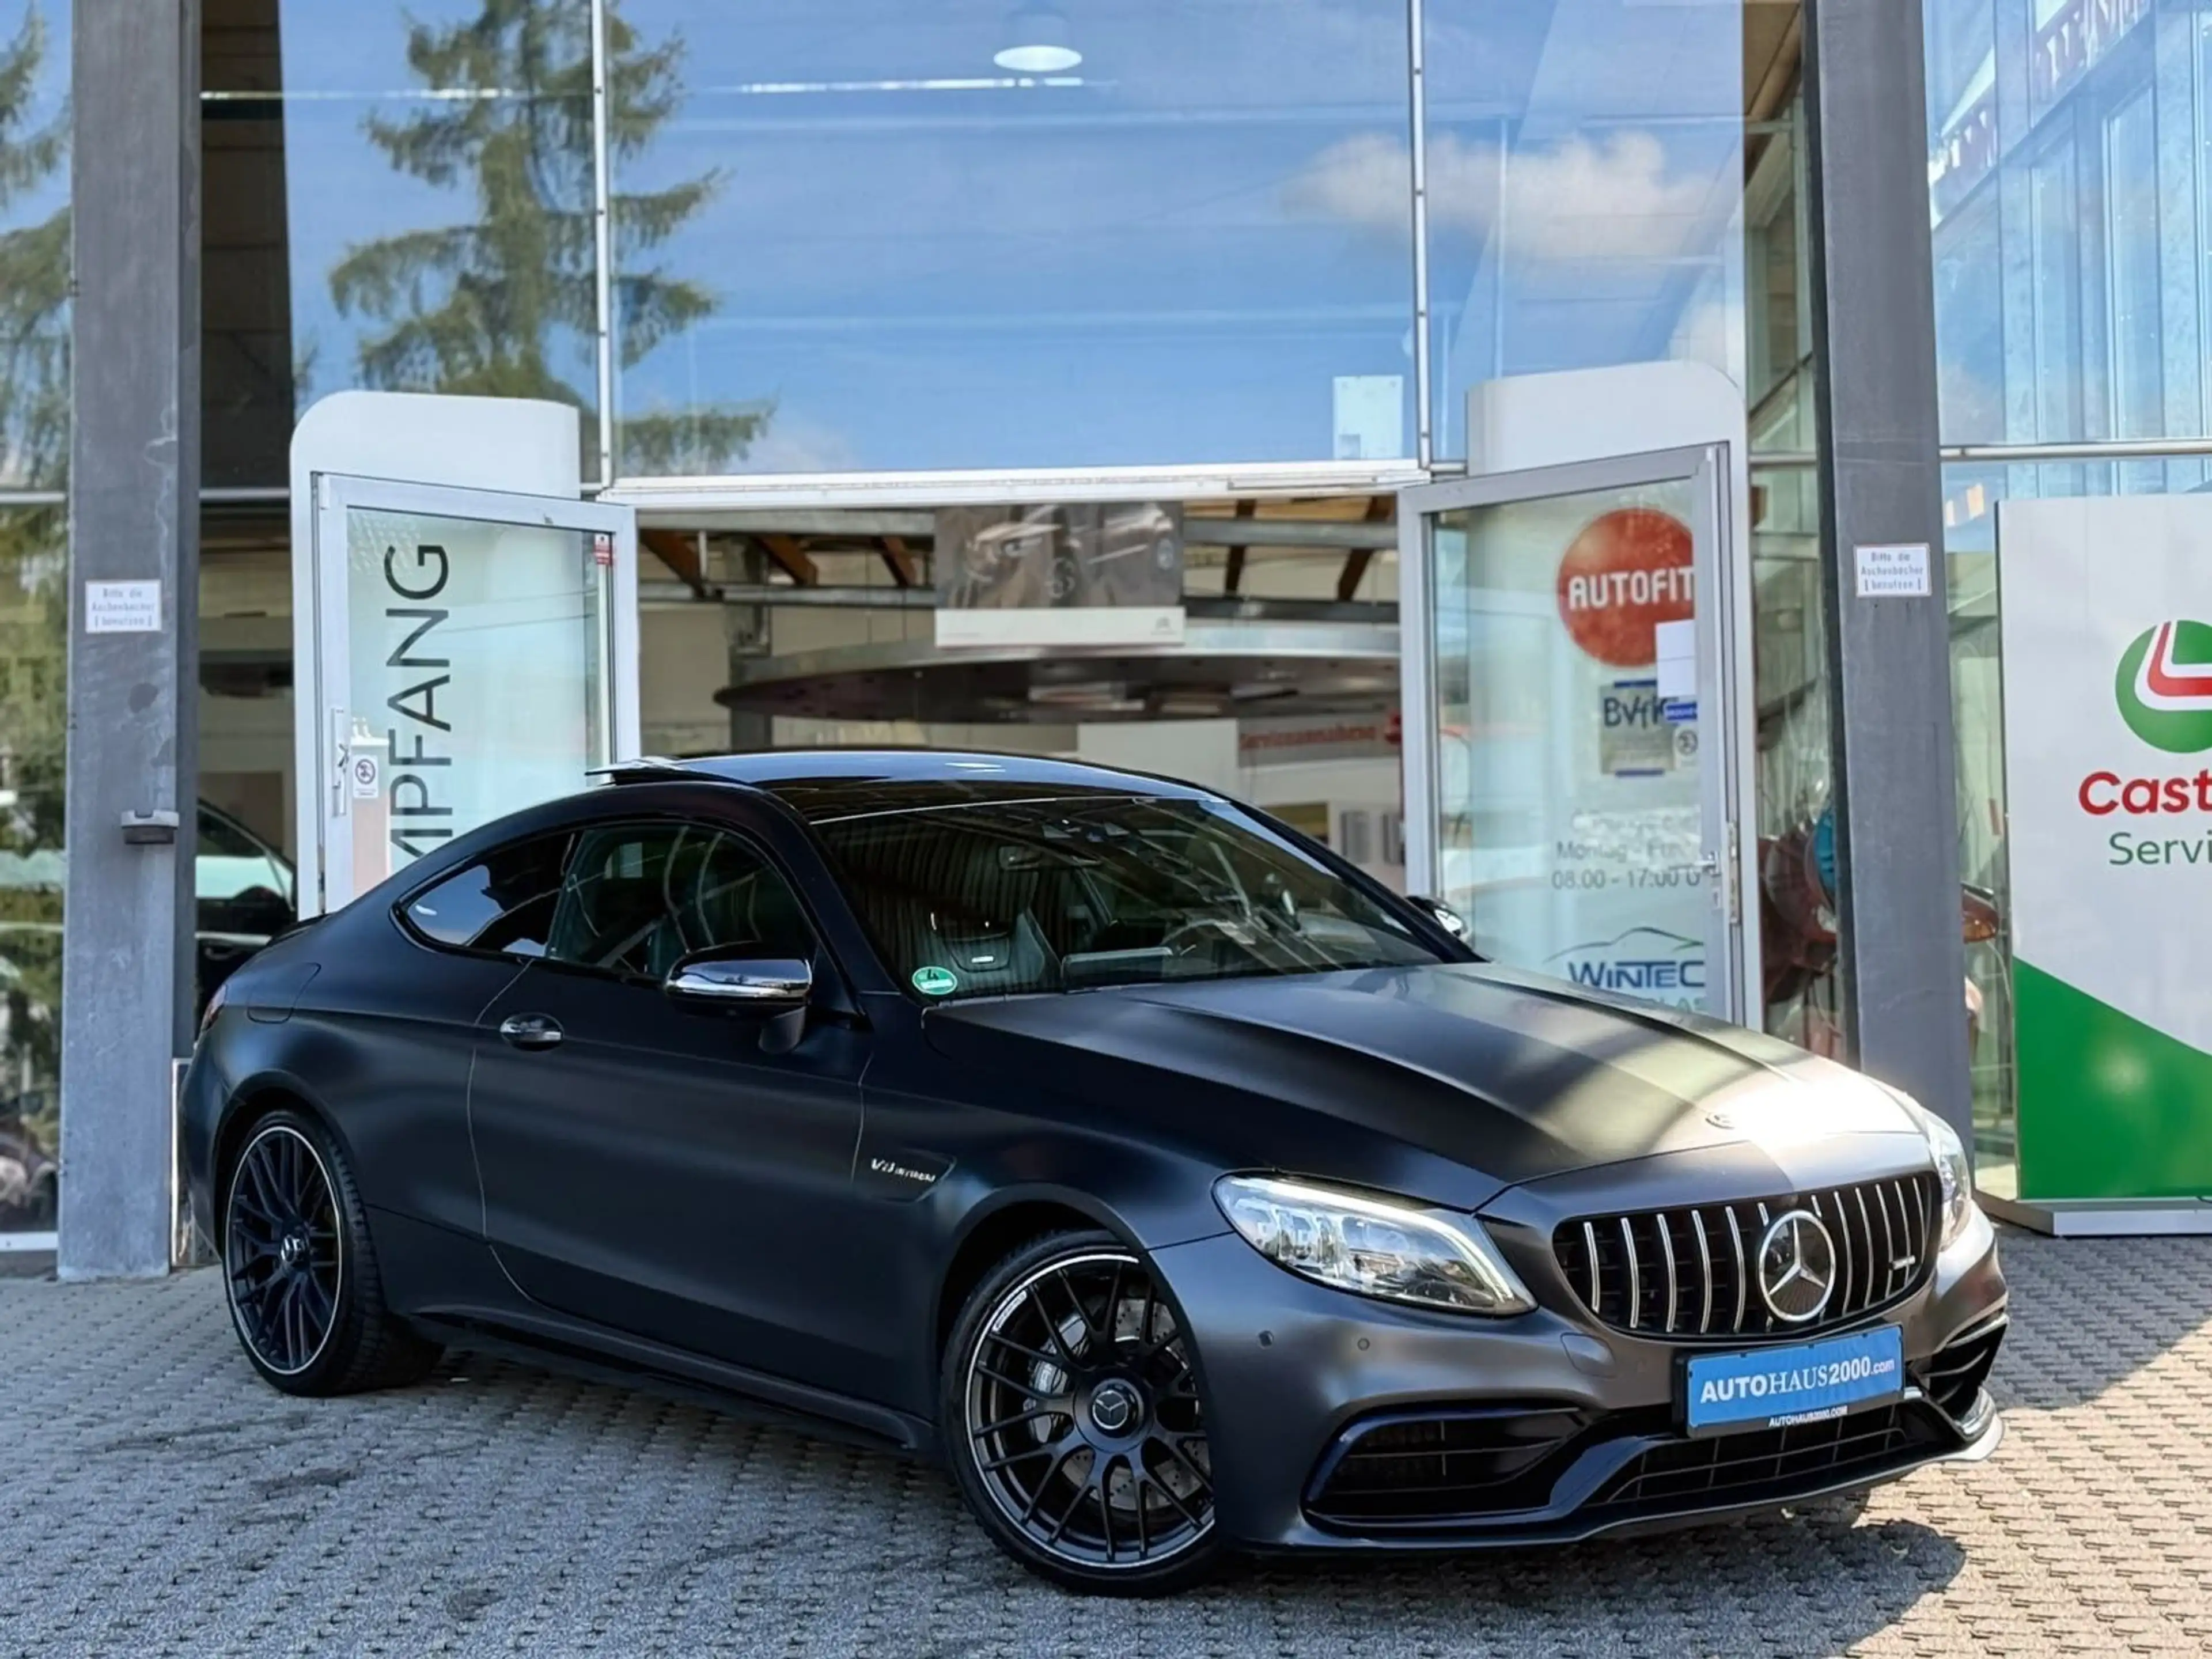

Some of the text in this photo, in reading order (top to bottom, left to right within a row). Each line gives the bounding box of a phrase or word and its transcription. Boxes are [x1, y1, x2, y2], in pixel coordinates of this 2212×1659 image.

[1569, 566, 1695, 610] AUTOFIT
[2078, 768, 2212, 815] Cast
[1700, 1356, 1895, 1404] AUTOHAUS2000.com
